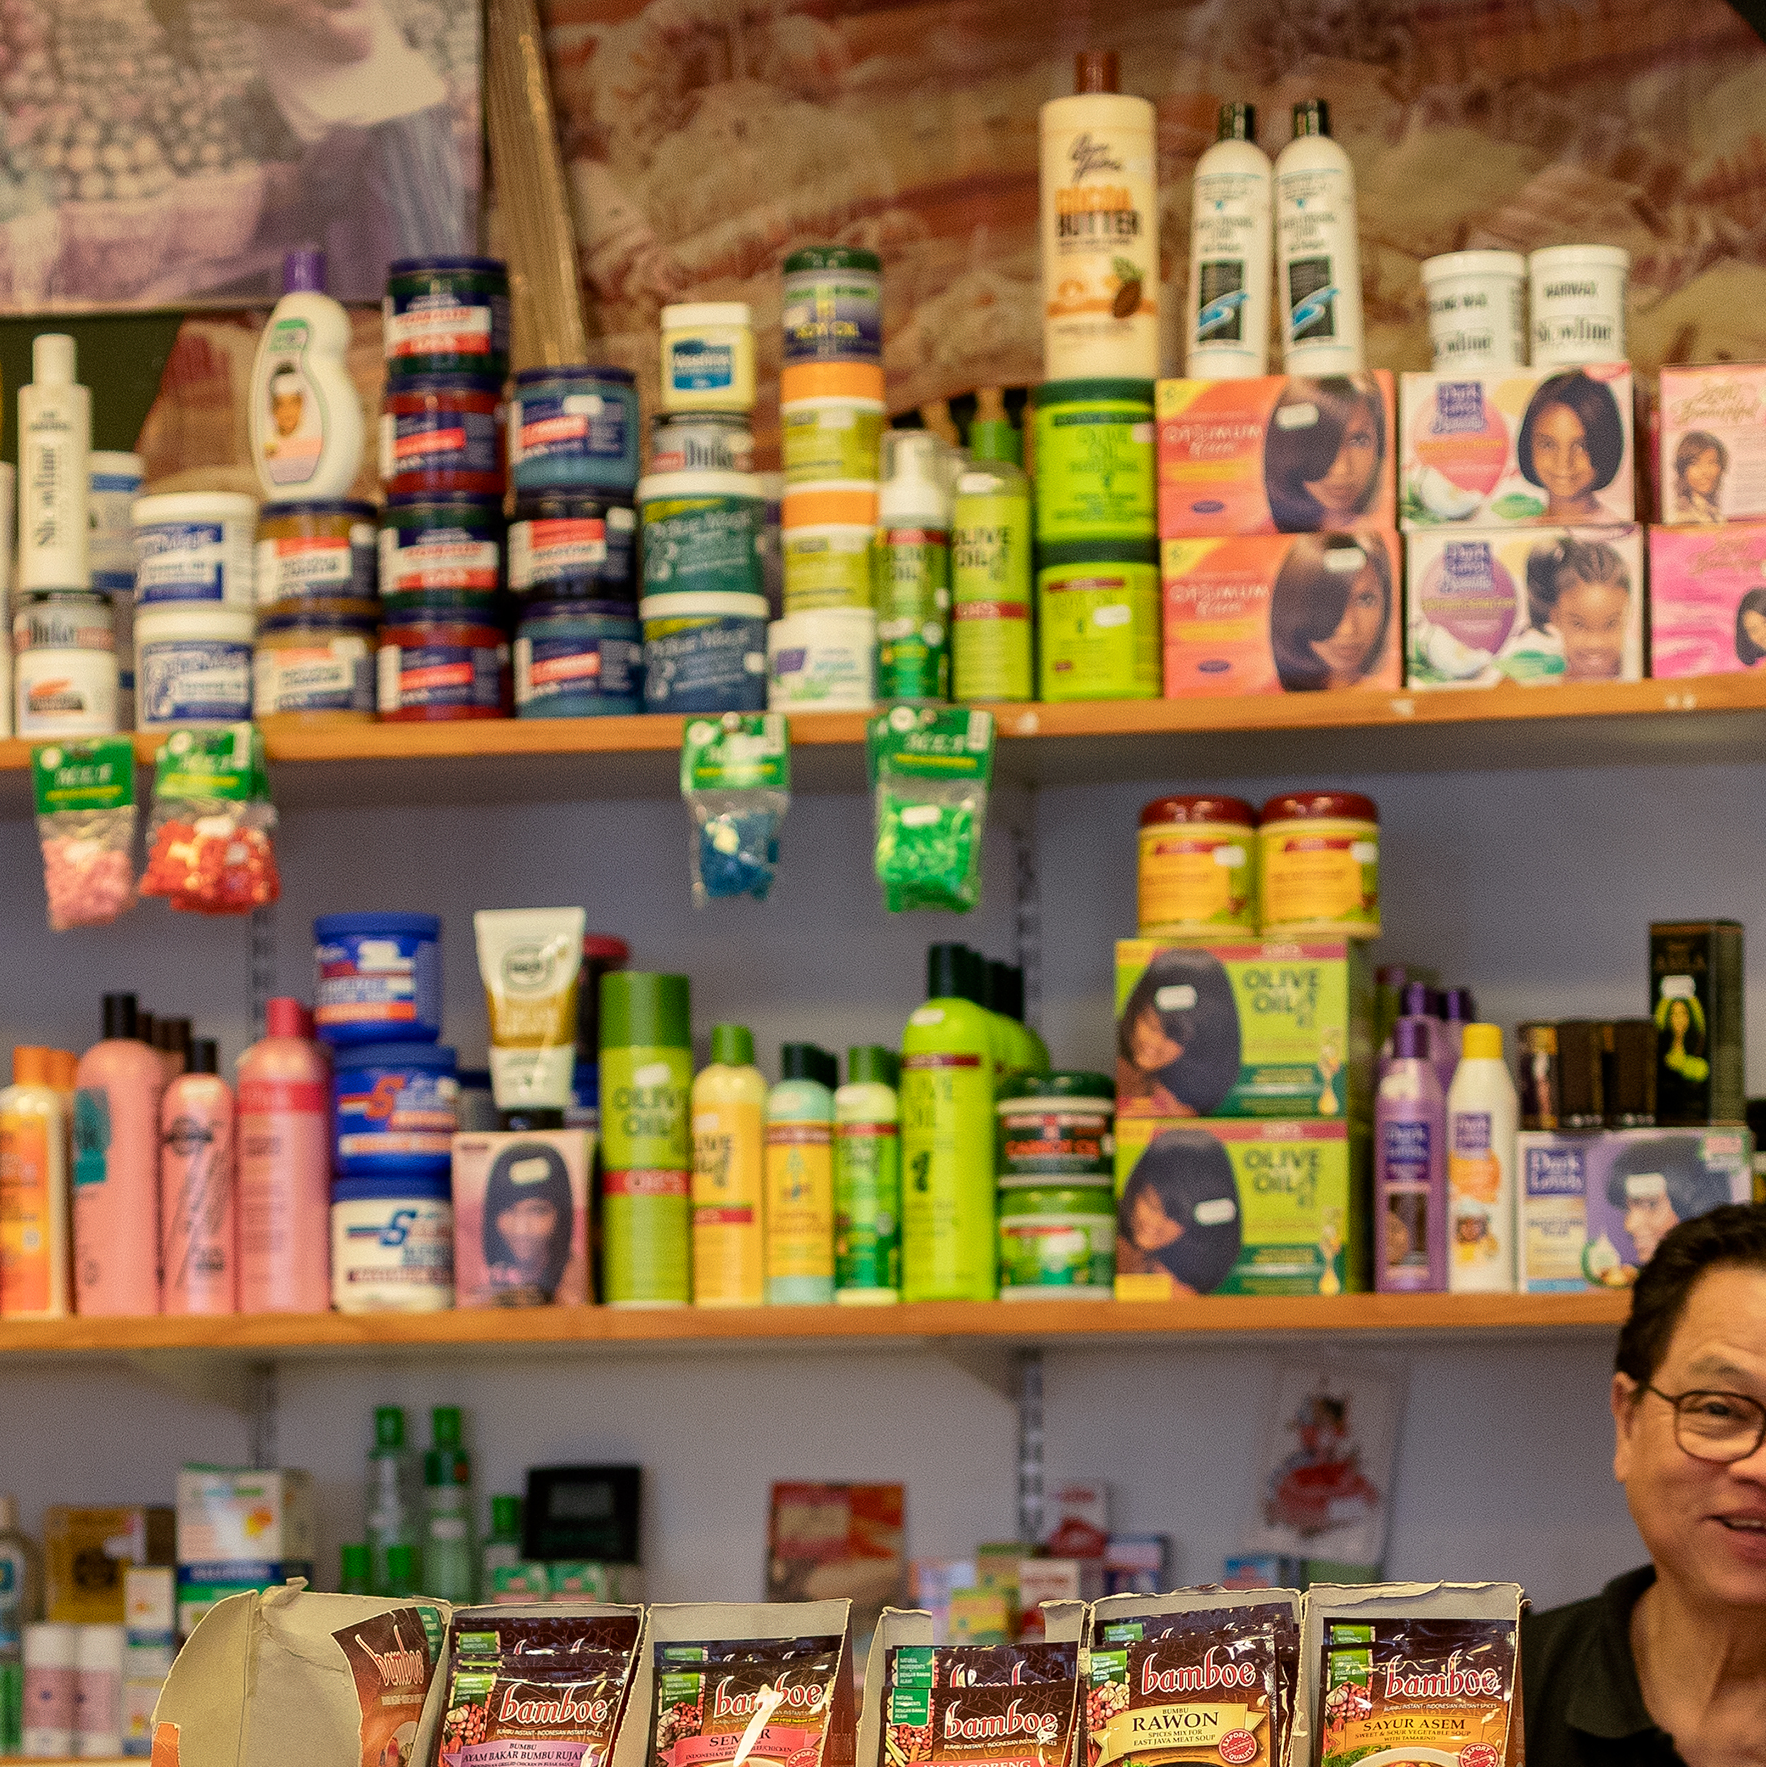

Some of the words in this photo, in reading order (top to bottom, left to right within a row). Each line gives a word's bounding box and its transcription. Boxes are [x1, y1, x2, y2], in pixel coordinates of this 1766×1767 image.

[1055, 212, 1142, 238] BUTTER
[1242, 968, 1322, 991] OLIVE
[1242, 1147, 1322, 1171] OLIVE
[1142, 1646, 1255, 1696] bamboe
[1385, 1649, 1498, 1699] bamboe
[499, 1682, 608, 1724] bamboe
[944, 1698, 1058, 1739] bamboe
[1132, 1712, 1219, 1732] RAWON
[1363, 1719, 1414, 1731] SAYUR
[1419, 1719, 1466, 1729] ASEM
[1172, 1736, 1193, 1744] MEAT
[1195, 1734, 1215, 1742] SOUP
[463, 1753, 487, 1762] AYAM
[489, 1751, 519, 1761] BAKAR
[521, 1751, 554, 1760] BUMBU
